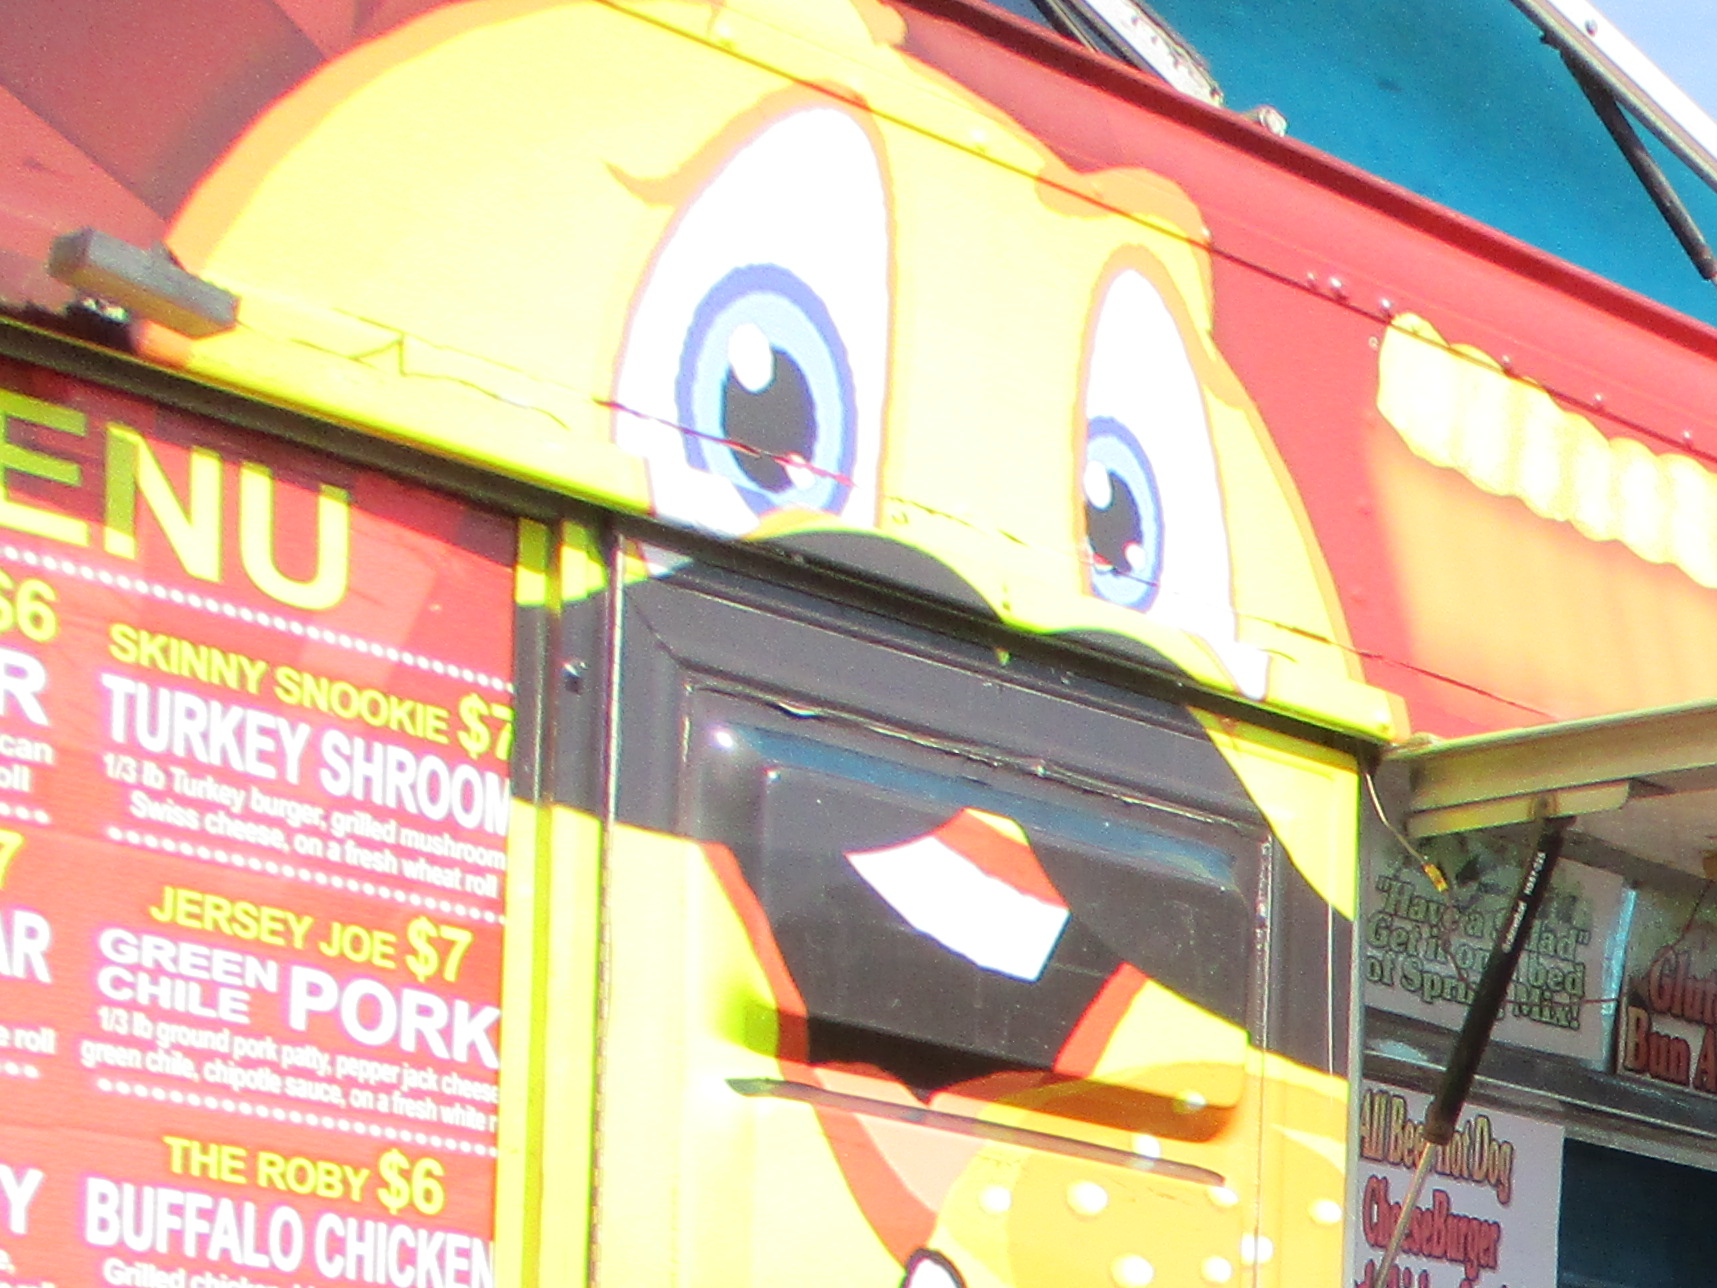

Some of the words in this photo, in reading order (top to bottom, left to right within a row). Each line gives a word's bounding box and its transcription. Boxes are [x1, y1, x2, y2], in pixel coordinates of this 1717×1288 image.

[0, 387, 349, 609] ENU
[101, 673, 311, 784] TURKEY
[109, 623, 266, 694] SKINNY
[275, 665, 451, 744] SNOOKIE
[458, 694, 513, 759] $7
[99, 928, 278, 993] GREEN
[150, 886, 313, 949] JERSEY
[319, 922, 397, 970] JOE
[406, 916, 473, 982] $7
[97, 967, 251, 1024] CHILE
[288, 965, 500, 1069] PORK
[1623, 1006, 1690, 1087] Bun
[162, 1135, 247, 1183] THE
[257, 1151, 370, 1202] ROBY
[377, 1148, 446, 1215] $6
[84, 1176, 304, 1273] BUFFALO
